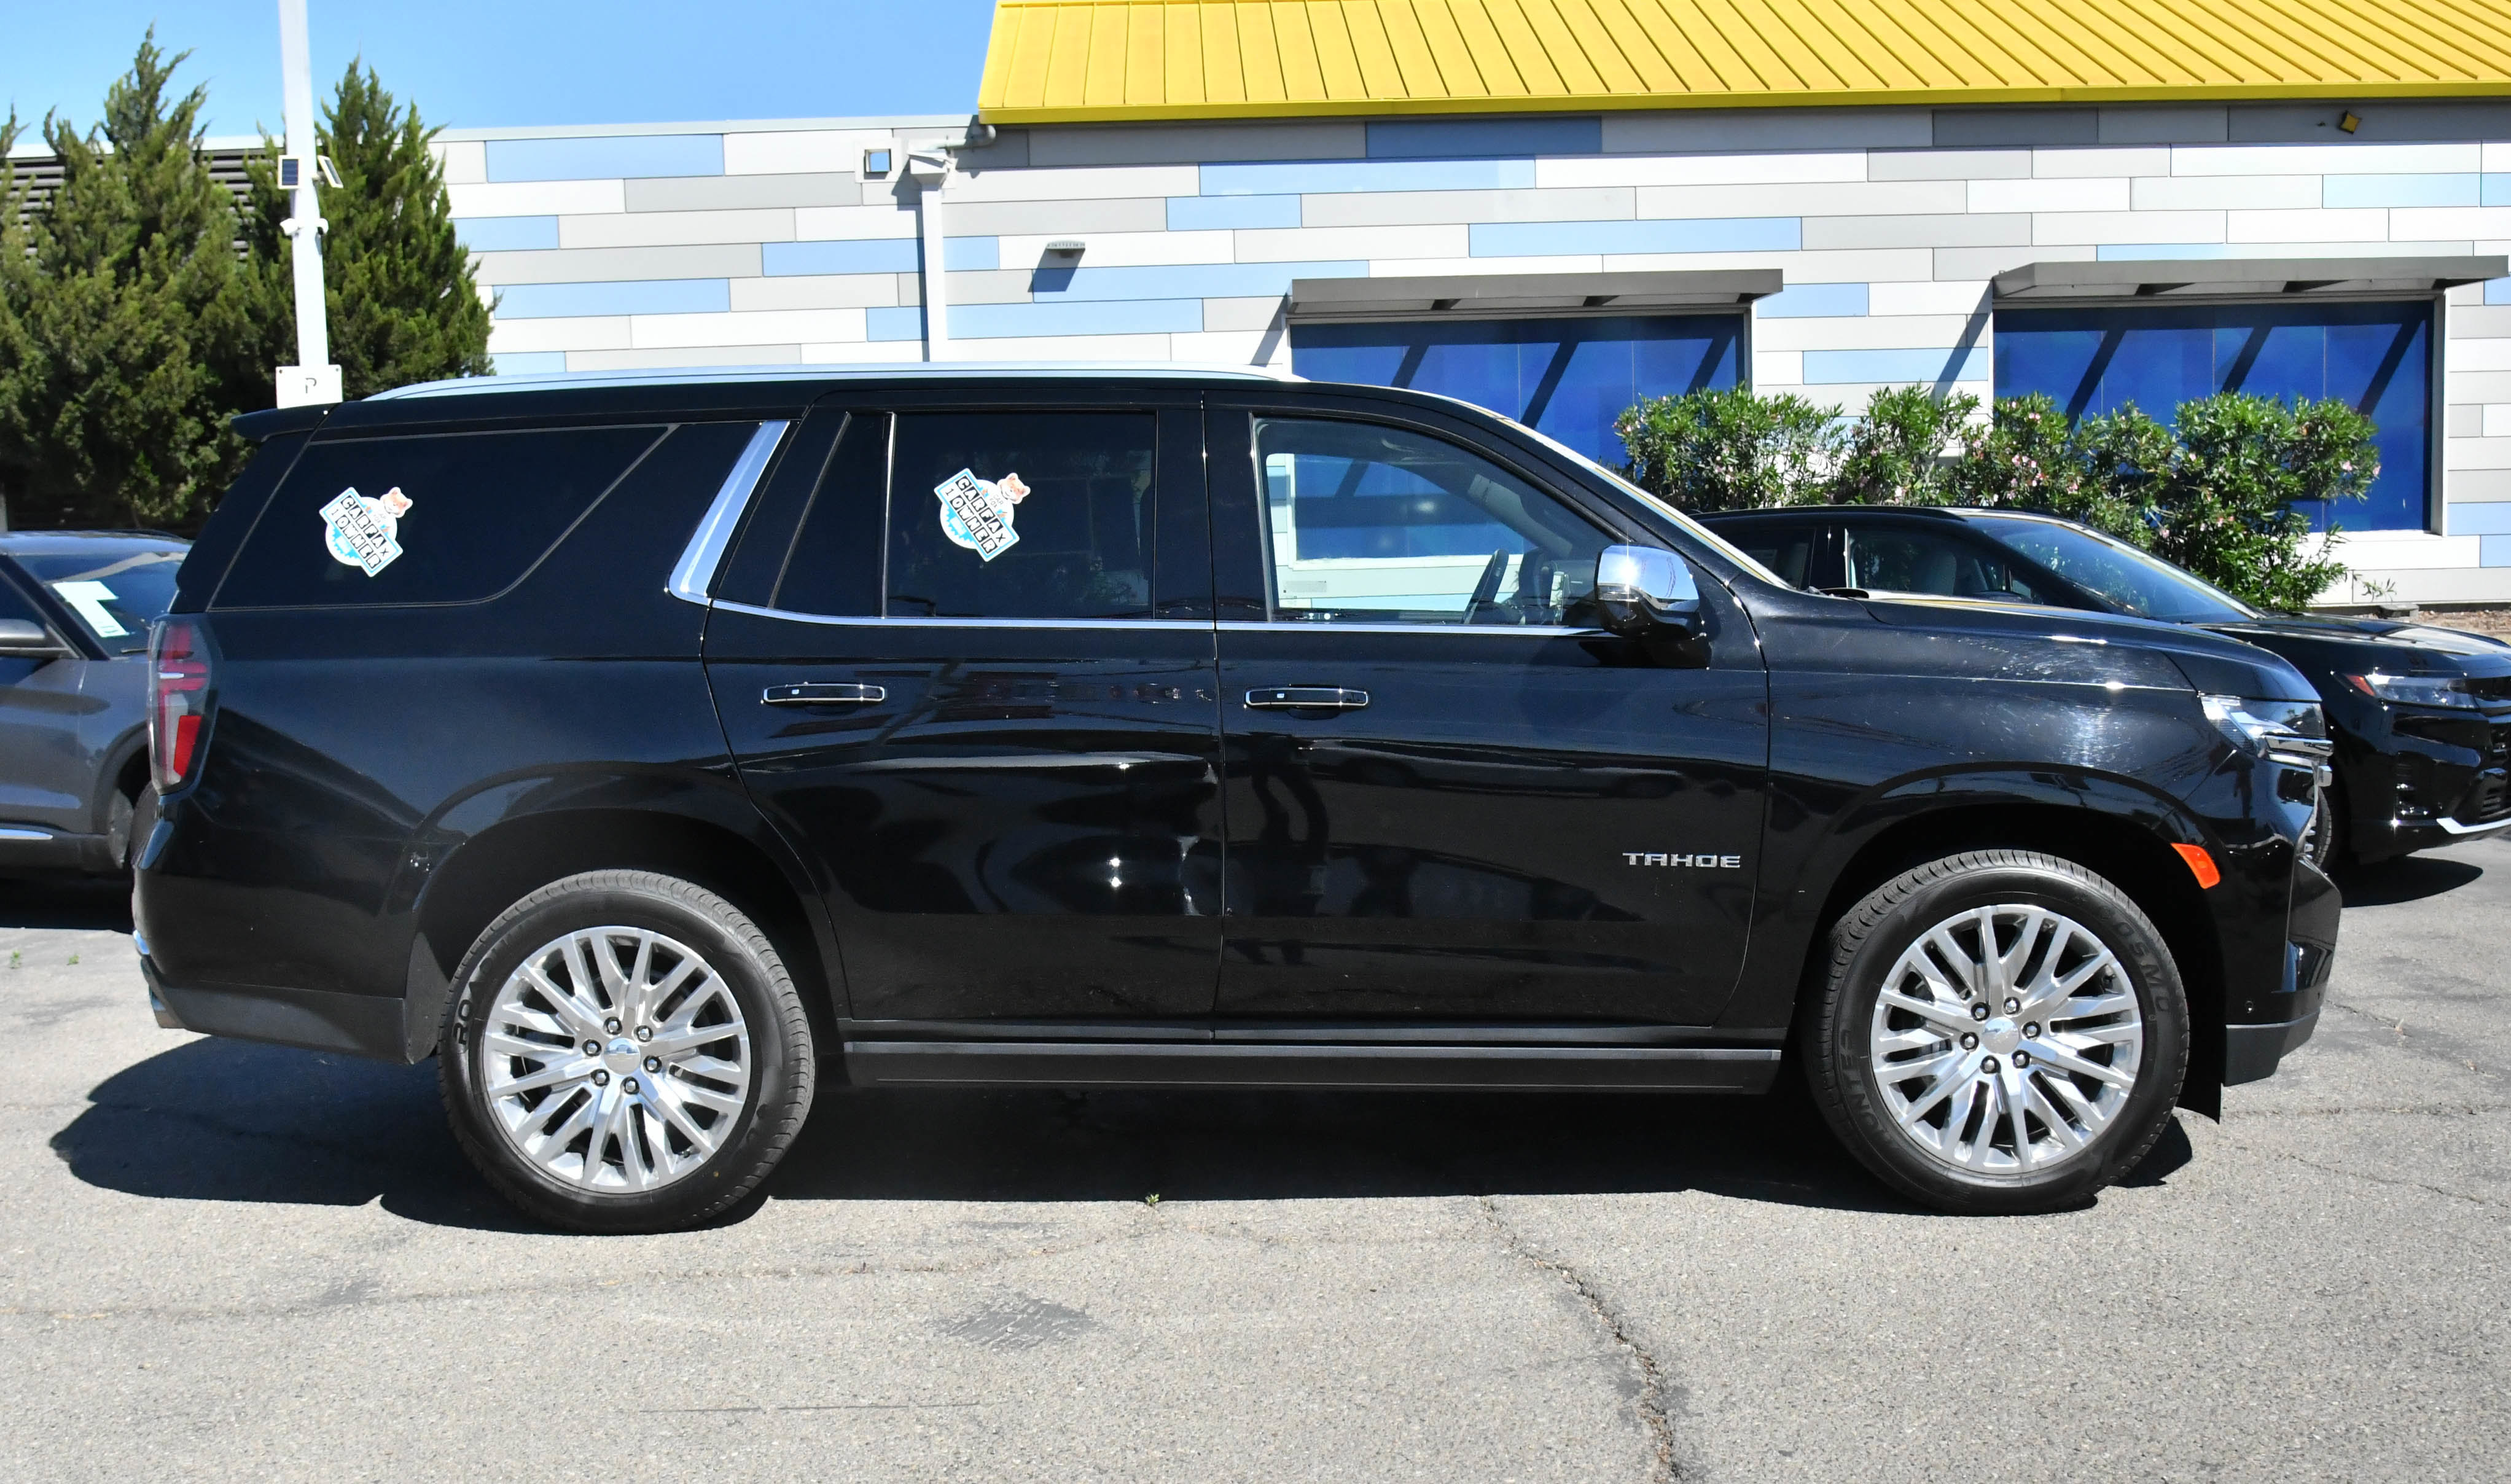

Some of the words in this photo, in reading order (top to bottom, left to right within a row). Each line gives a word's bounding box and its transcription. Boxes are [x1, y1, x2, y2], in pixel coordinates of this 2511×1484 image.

[341, 495, 389, 556] CARFAX
[945, 488, 954, 496] 1
[950, 495, 998, 553] OWNER
[955, 476, 1006, 542] CARFAX
[335, 515, 381, 569] OWNER
[1622, 852, 1741, 869] TAHOE
